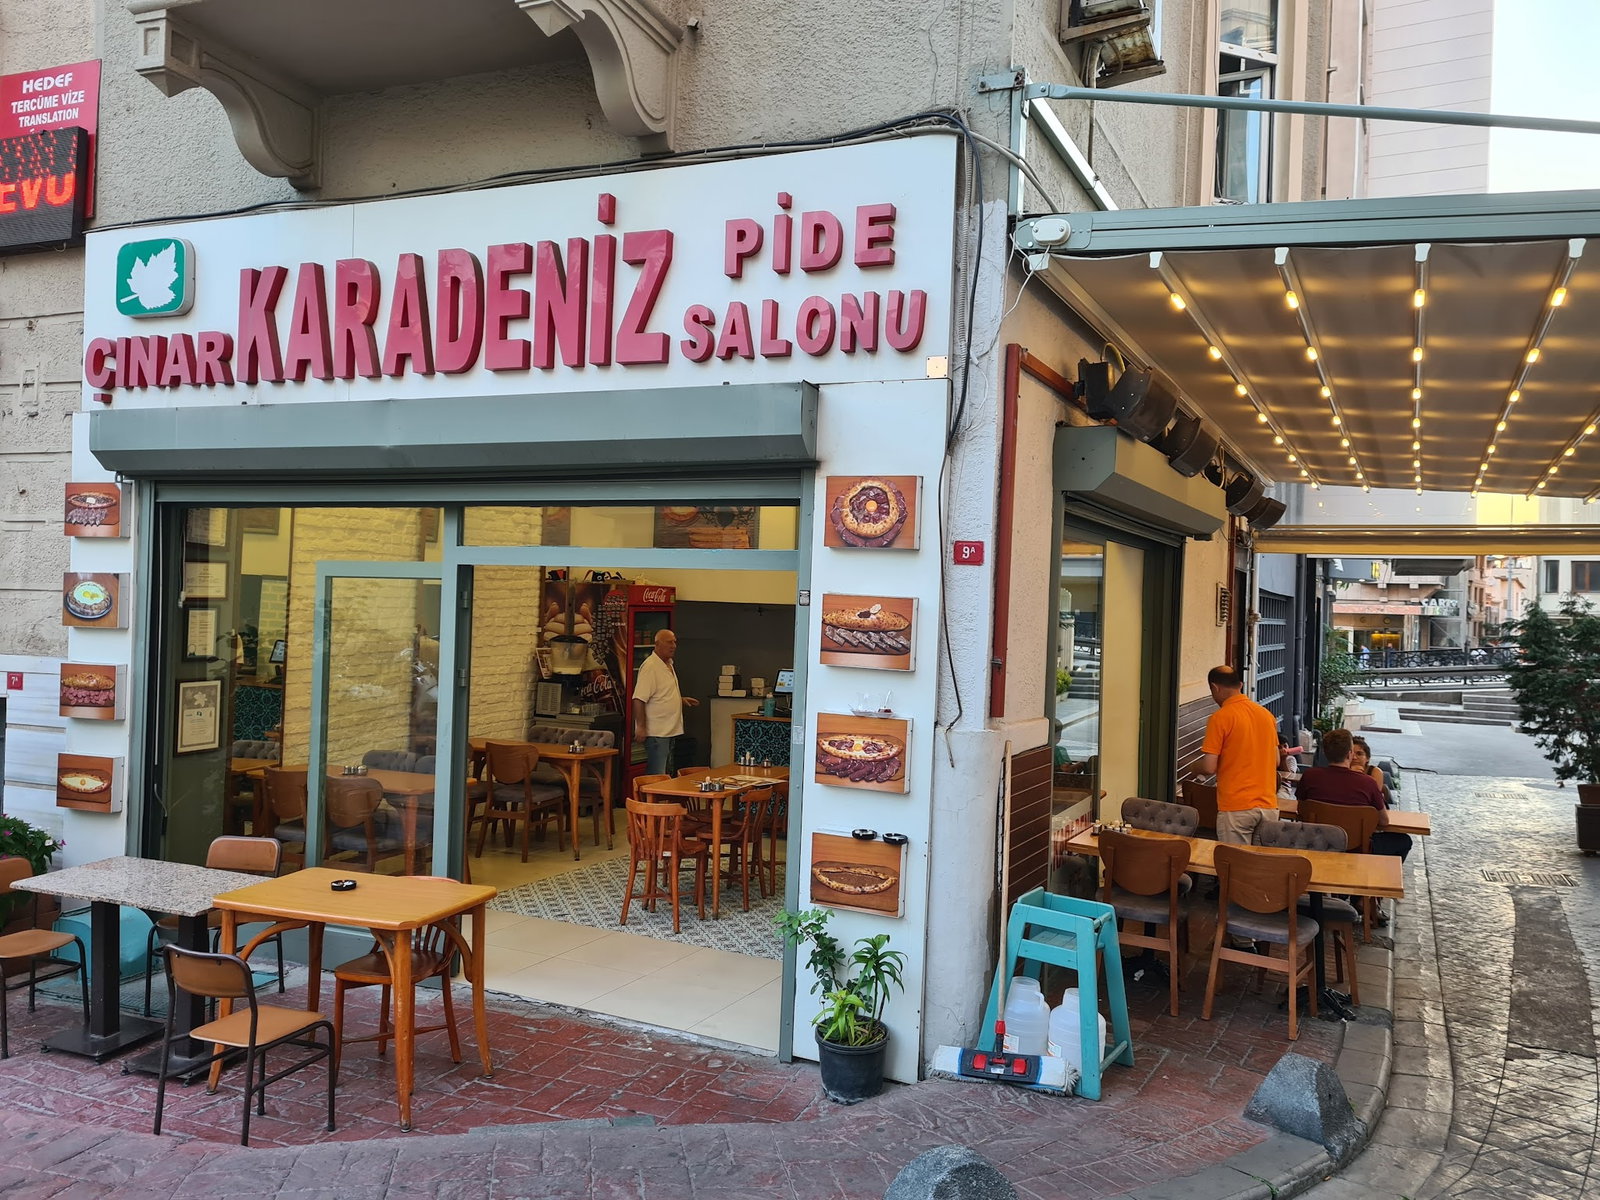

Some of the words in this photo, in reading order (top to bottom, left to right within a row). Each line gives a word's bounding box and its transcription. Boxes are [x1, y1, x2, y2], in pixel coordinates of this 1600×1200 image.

[11, 94, 59, 114] TERCÜME
[61, 89, 85, 106] VİZE
[22, 72, 73, 94] HEDEF
[19, 107, 79, 128] TRANSLATION
[724, 191, 896, 279] PİDE
[84, 331, 234, 404] ÇINAR
[236, 192, 674, 384] KARADENİZ
[680, 289, 927, 363] SALONU
